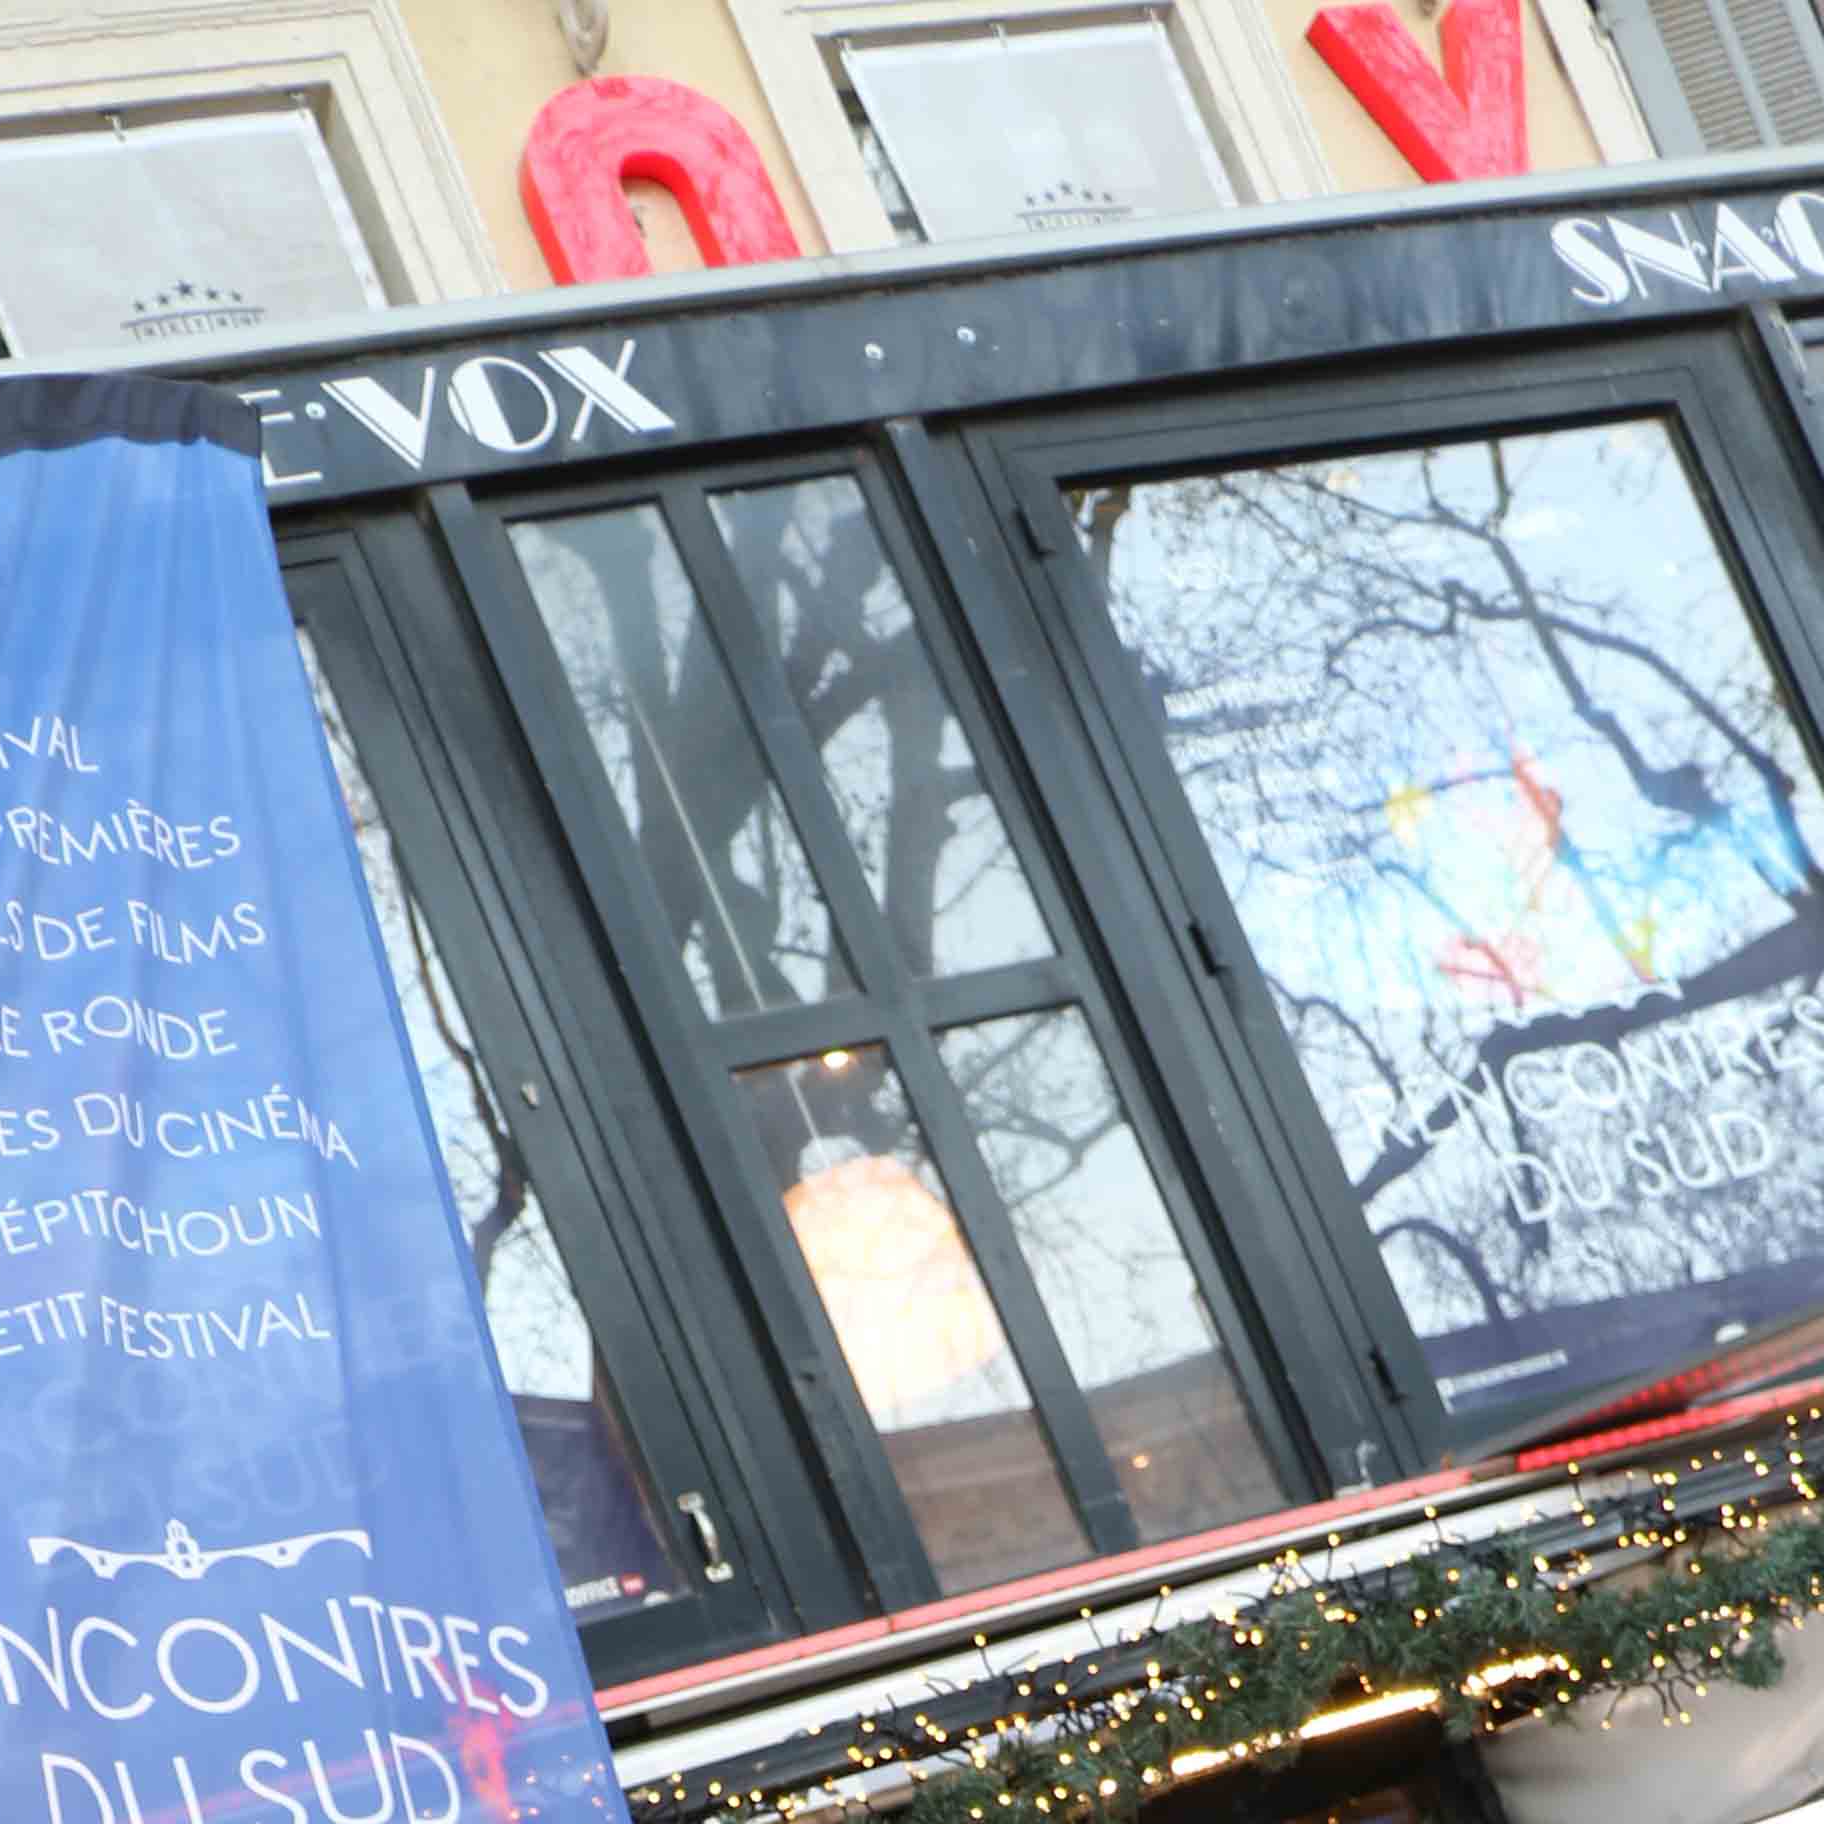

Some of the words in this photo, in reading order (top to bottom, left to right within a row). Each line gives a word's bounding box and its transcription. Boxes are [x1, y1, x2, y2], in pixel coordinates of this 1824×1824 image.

[33, 906, 116, 962] DE
[127, 901, 267, 965] FILMS
[42, 995, 239, 1062] RONDE
[74, 1093, 146, 1150] DU
[156, 1083, 360, 1169] CINÉMA
[1501, 1146, 1612, 1224] DU
[1625, 1110, 1775, 1197] SUD
[101, 1294, 332, 1362] FESTIVAL
